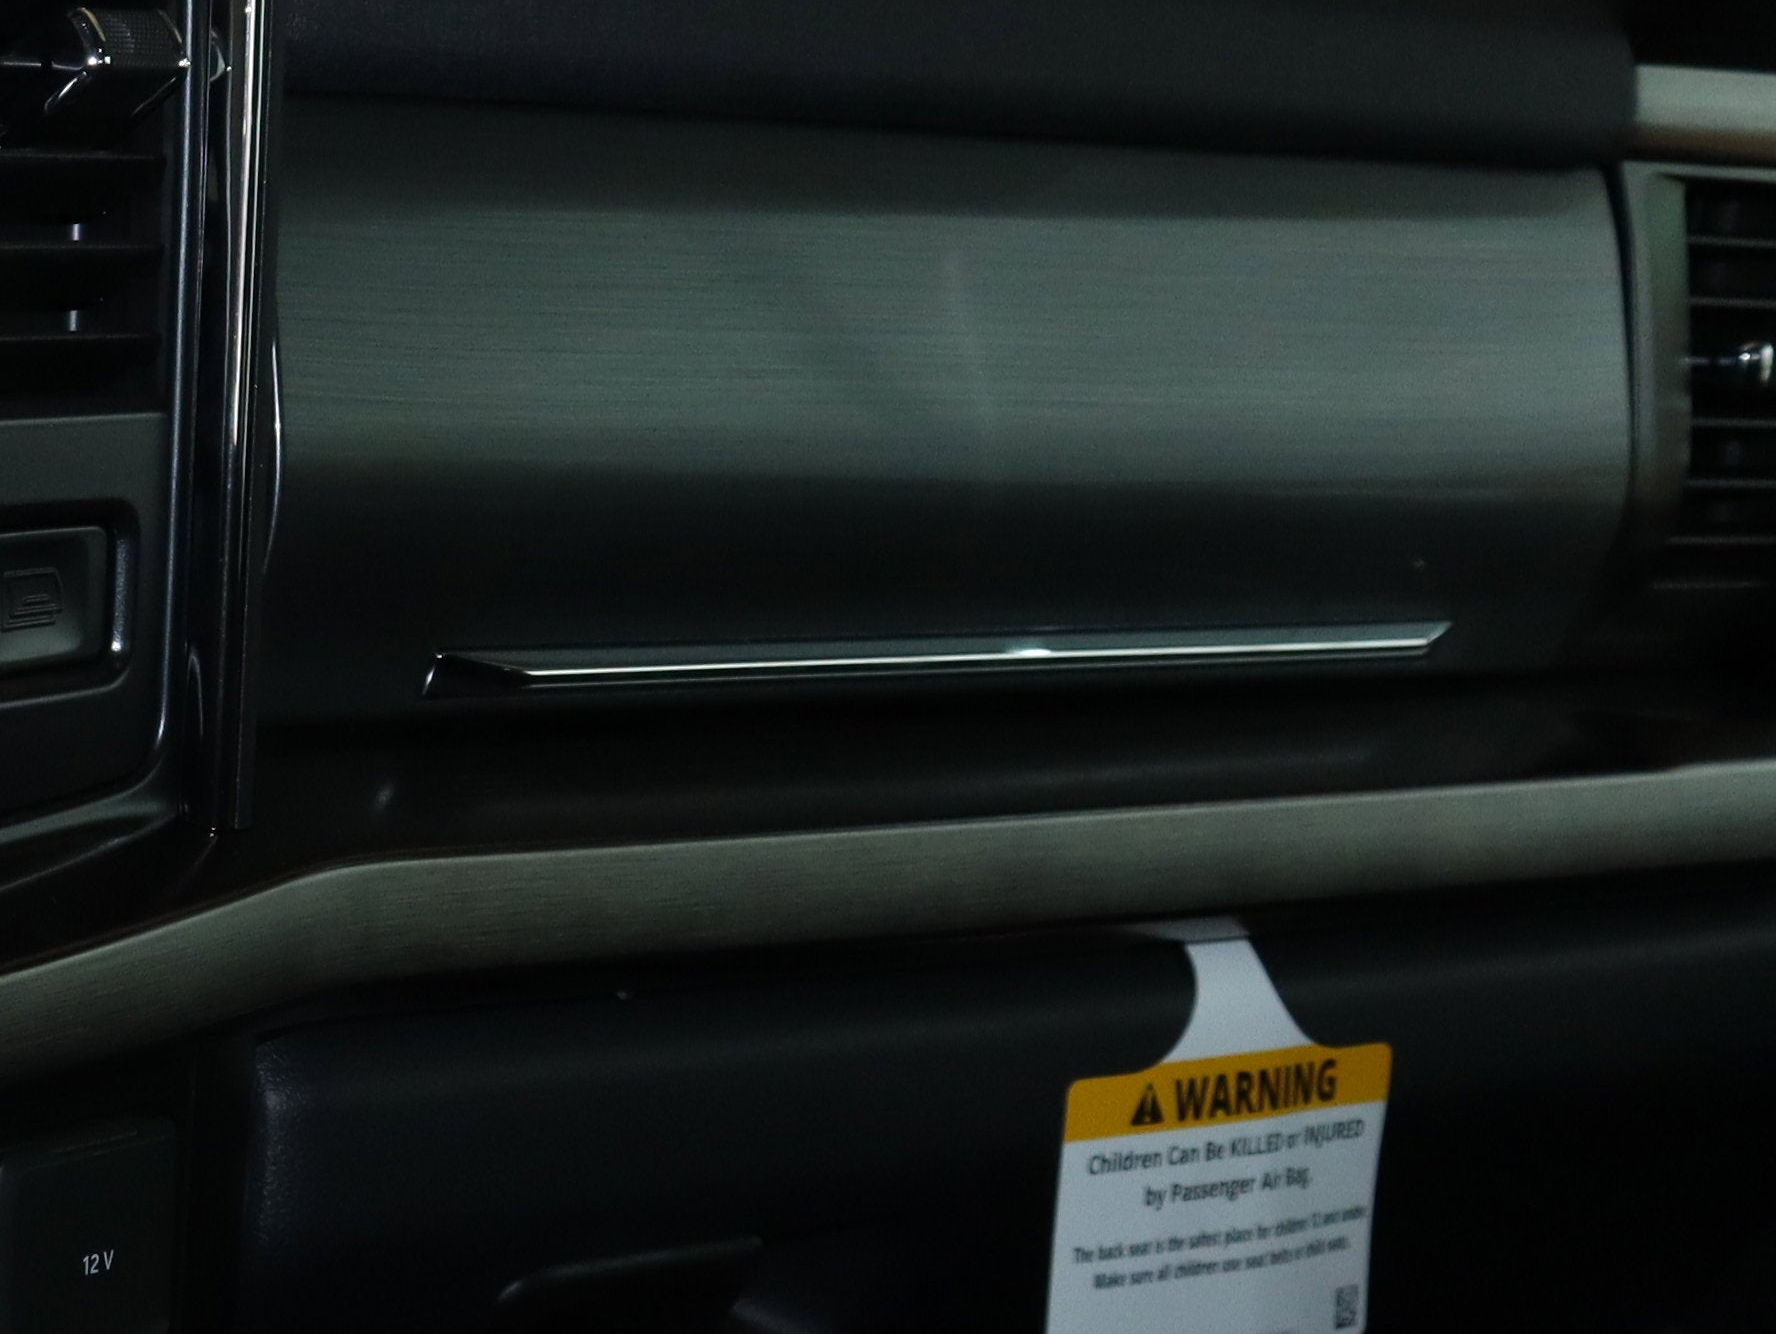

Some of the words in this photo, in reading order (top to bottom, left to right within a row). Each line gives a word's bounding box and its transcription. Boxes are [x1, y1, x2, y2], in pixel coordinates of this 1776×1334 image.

[1175, 1058, 1338, 1122] WARNING
[1088, 1150, 1163, 1176] Children
[1167, 1145, 1198, 1166] Can
[1205, 1141, 1225, 1163] Be
[1230, 1133, 1283, 1157] KILLED
[1304, 1118, 1366, 1148] INJURED
[1145, 1185, 1166, 1211] by
[1170, 1176, 1256, 1203] Passenger
[1260, 1170, 1282, 1191] Air
[82, 1253, 101, 1276] 12
[101, 1248, 115, 1271] V
